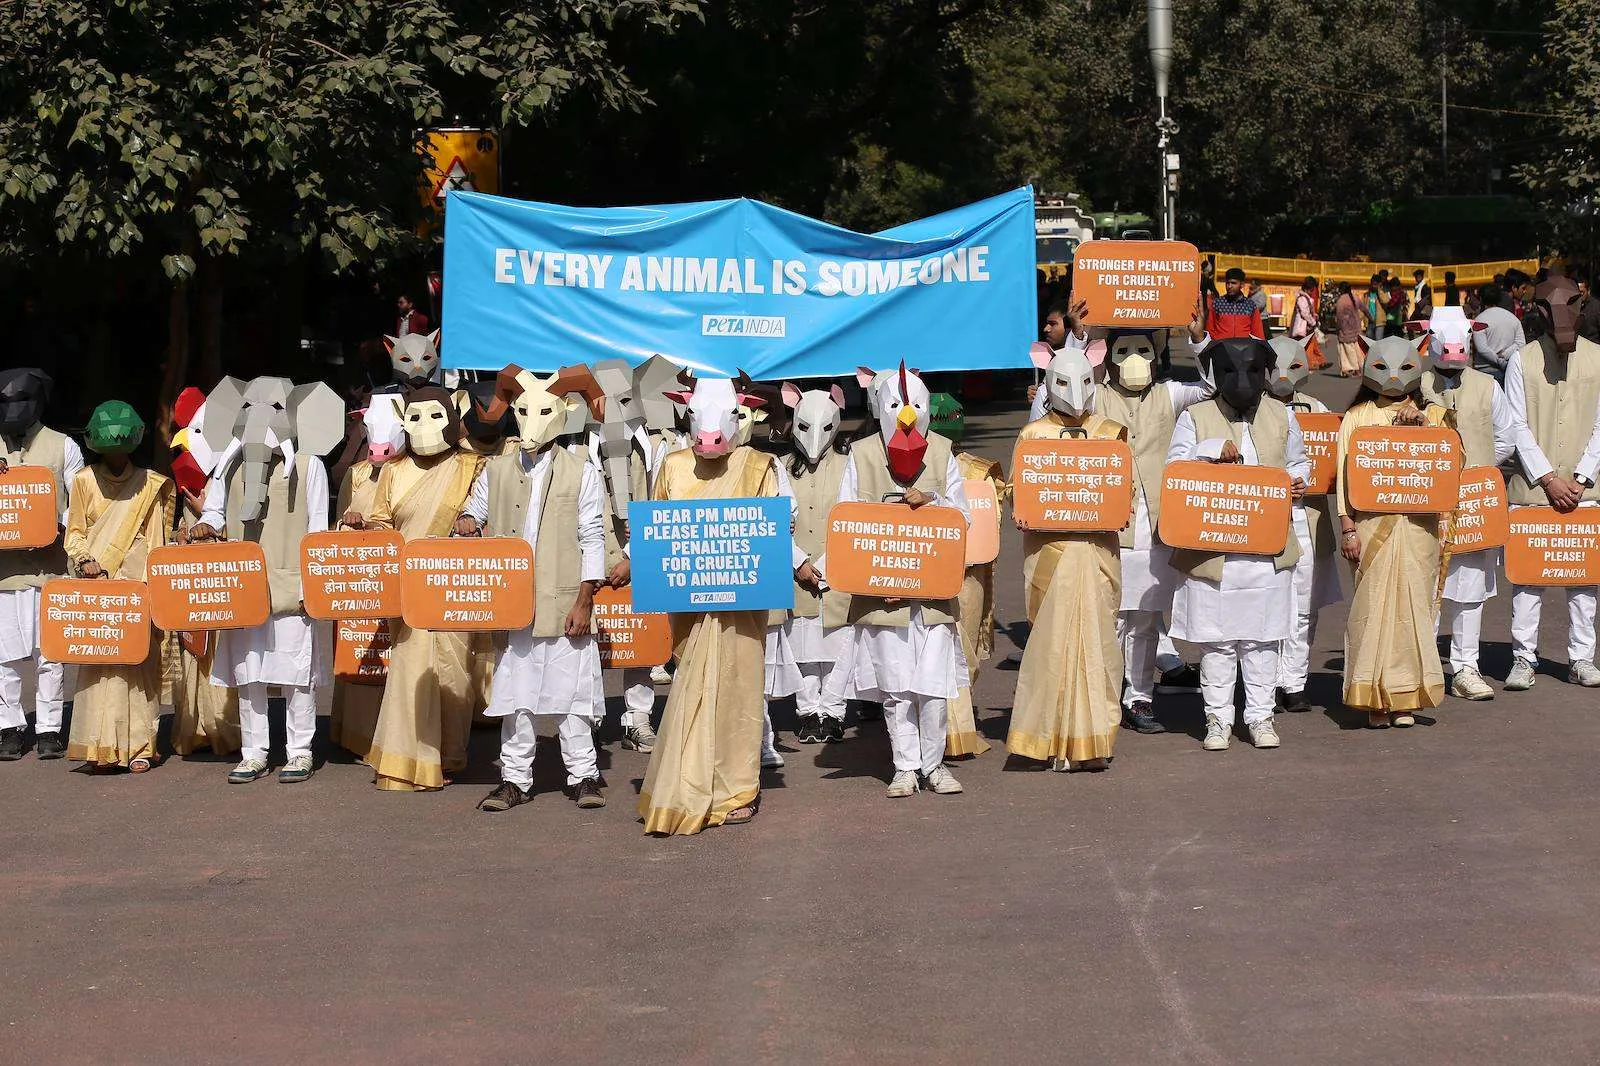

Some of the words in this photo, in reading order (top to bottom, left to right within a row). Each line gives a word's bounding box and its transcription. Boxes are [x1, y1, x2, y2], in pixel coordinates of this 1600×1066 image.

[495, 248, 613, 288] EVERY
[620, 256, 764, 293] ANIMAL
[773, 260, 808, 295] IS
[818, 246, 989, 296] SOMEONE
[1079, 259, 1134, 270] STRONGER
[1138, 260, 1194, 272] PENALTIES
[1099, 274, 1119, 285] FOR
[1123, 275, 1173, 288] CRUELTY,
[1116, 290, 1159, 300] PLEASE!
[1302, 431, 1338, 442] ENALTI
[1357, 439, 1389, 455] पशुओं
[1392, 442, 1406, 452] पर
[1409, 443, 1437, 456] क्रूरता
[1440, 440, 1451, 453] के
[1023, 452, 1057, 469] पशुओं
[1060, 456, 1075, 466] पर
[1078, 456, 1107, 470] क्रूरता
[1110, 454, 1122, 467] के
[1356, 455, 1395, 468] खिलाफ
[1397, 459, 1431, 473] मजबूत
[1435, 458, 1451, 471] दंड
[1022, 471, 1063, 484] खिलाफ
[1066, 474, 1103, 489] मजबूत
[1105, 472, 1123, 486] दंड
[1372, 473, 1394, 486] होना
[1397, 474, 1432, 489] चाहिए।
[1484, 479, 1496, 491] के
[0, 484, 51, 494] ENALTIES
[1167, 478, 1224, 493] STRONGER
[1228, 483, 1286, 498] PENALTIES
[1039, 488, 1063, 503] होना
[1066, 490, 1103, 505] चाहिए।
[1483, 496, 1498, 508] दंड
[1186, 496, 1207, 507] FOR
[1211, 498, 1263, 514] CRUELTY,
[653, 509, 691, 524] DEAR
[696, 508, 718, 522] PM
[724, 507, 766, 524] MODI,
[1203, 513, 1248, 526] PLEASE!
[644, 525, 699, 540] PLEASE
[704, 523, 776, 538] INCREASE
[833, 520, 894, 535] STRONGER
[898, 525, 960, 540] PENALTIES
[1510, 524, 1561, 534] STRONGER
[672, 539, 750, 556] PENALTIES
[854, 538, 876, 550] FOR
[881, 540, 936, 557] CRUELTY,
[1528, 538, 1547, 547] FOR
[1551, 538, 1598, 548] CRUELTY,
[308, 544, 338, 560] पशुओं
[340, 548, 354, 557] पर
[357, 547, 384, 561] क्रूरता
[386, 543, 397, 556] के
[1545, 552, 1585, 561] PLEASE!
[152, 563, 203, 576] STRONGER
[207, 560, 261, 573] PENALTIES
[308, 560, 345, 575] खिलाफ
[348, 564, 381, 578] मजबूत
[383, 561, 399, 574] दंड
[406, 558, 464, 569] STRONGER
[468, 558, 528, 570] PENALTIES
[663, 557, 690, 571] FOR
[695, 555, 760, 570] CRUELTY
[873, 556, 920, 569] PLEASE!
[171, 579, 190, 589] FOR
[194, 577, 242, 588] CRUELTY,
[427, 574, 448, 585] FOR
[453, 574, 506, 587] CRUELTY,
[667, 573, 686, 586] TO
[691, 571, 757, 586] ANIMALS
[323, 579, 346, 594] होना
[348, 579, 383, 593] चाहिए।
[49, 591, 80, 607] पशुओं
[83, 595, 97, 605] पर
[100, 596, 127, 609] क्रूरता
[130, 593, 141, 606] के
[189, 592, 230, 603] PLEASE!
[446, 591, 491, 601] PLEASE!
[47, 606, 86, 620] खिलाफ
[89, 612, 123, 624] मजबूत
[126, 611, 141, 623] दंड
[63, 624, 86, 638] होना
[89, 624, 123, 640] चाहिए।
[340, 628, 375, 641] खिलाफ
[598, 632, 634, 642] LEASE!
